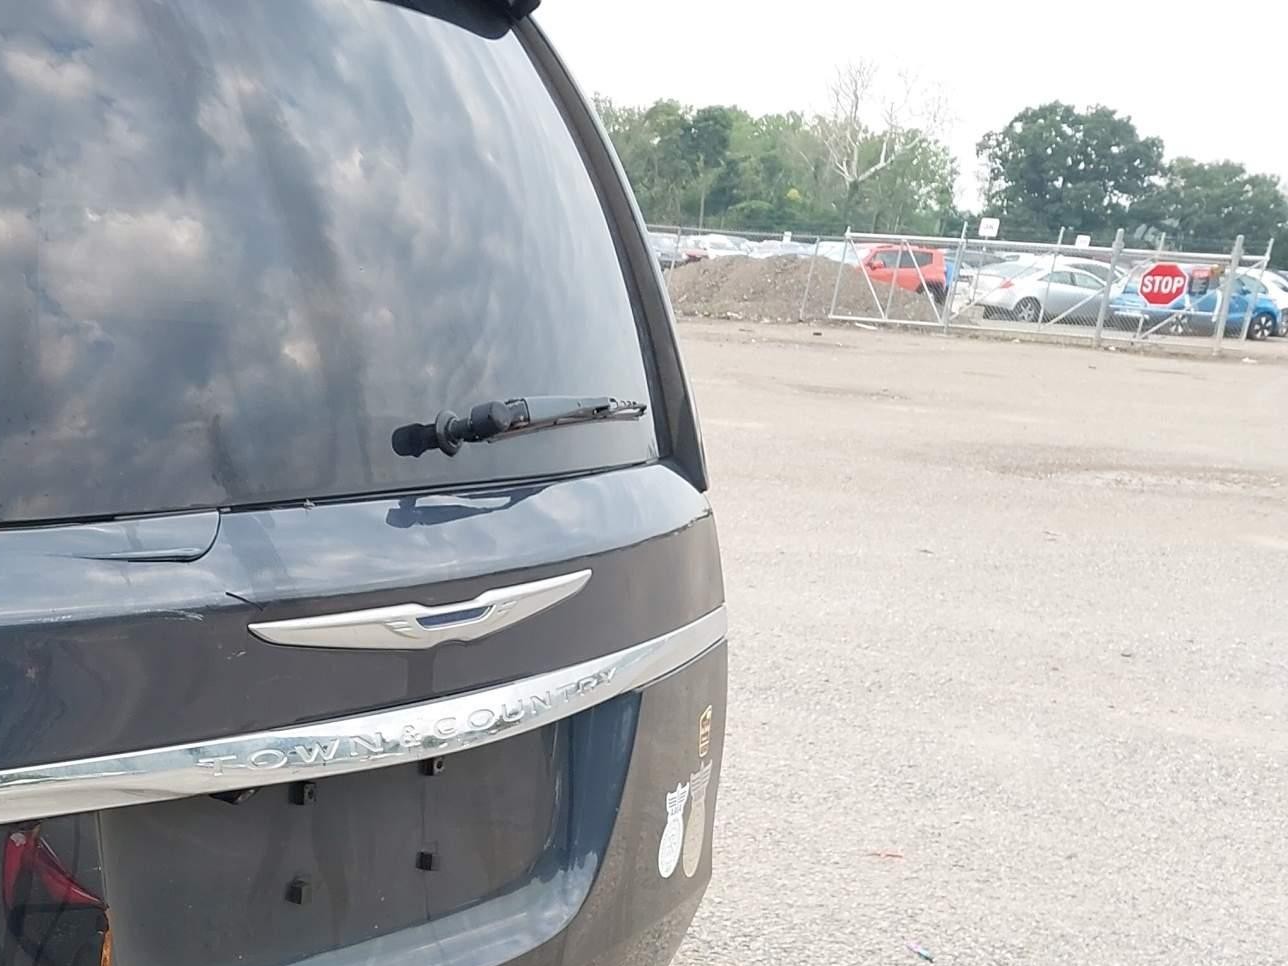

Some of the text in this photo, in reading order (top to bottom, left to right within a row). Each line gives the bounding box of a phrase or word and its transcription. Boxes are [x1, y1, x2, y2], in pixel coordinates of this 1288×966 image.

[1142, 275, 1185, 295] STOP
[198, 732, 384, 777] TOWN
[432, 666, 617, 739] COUNTRY
